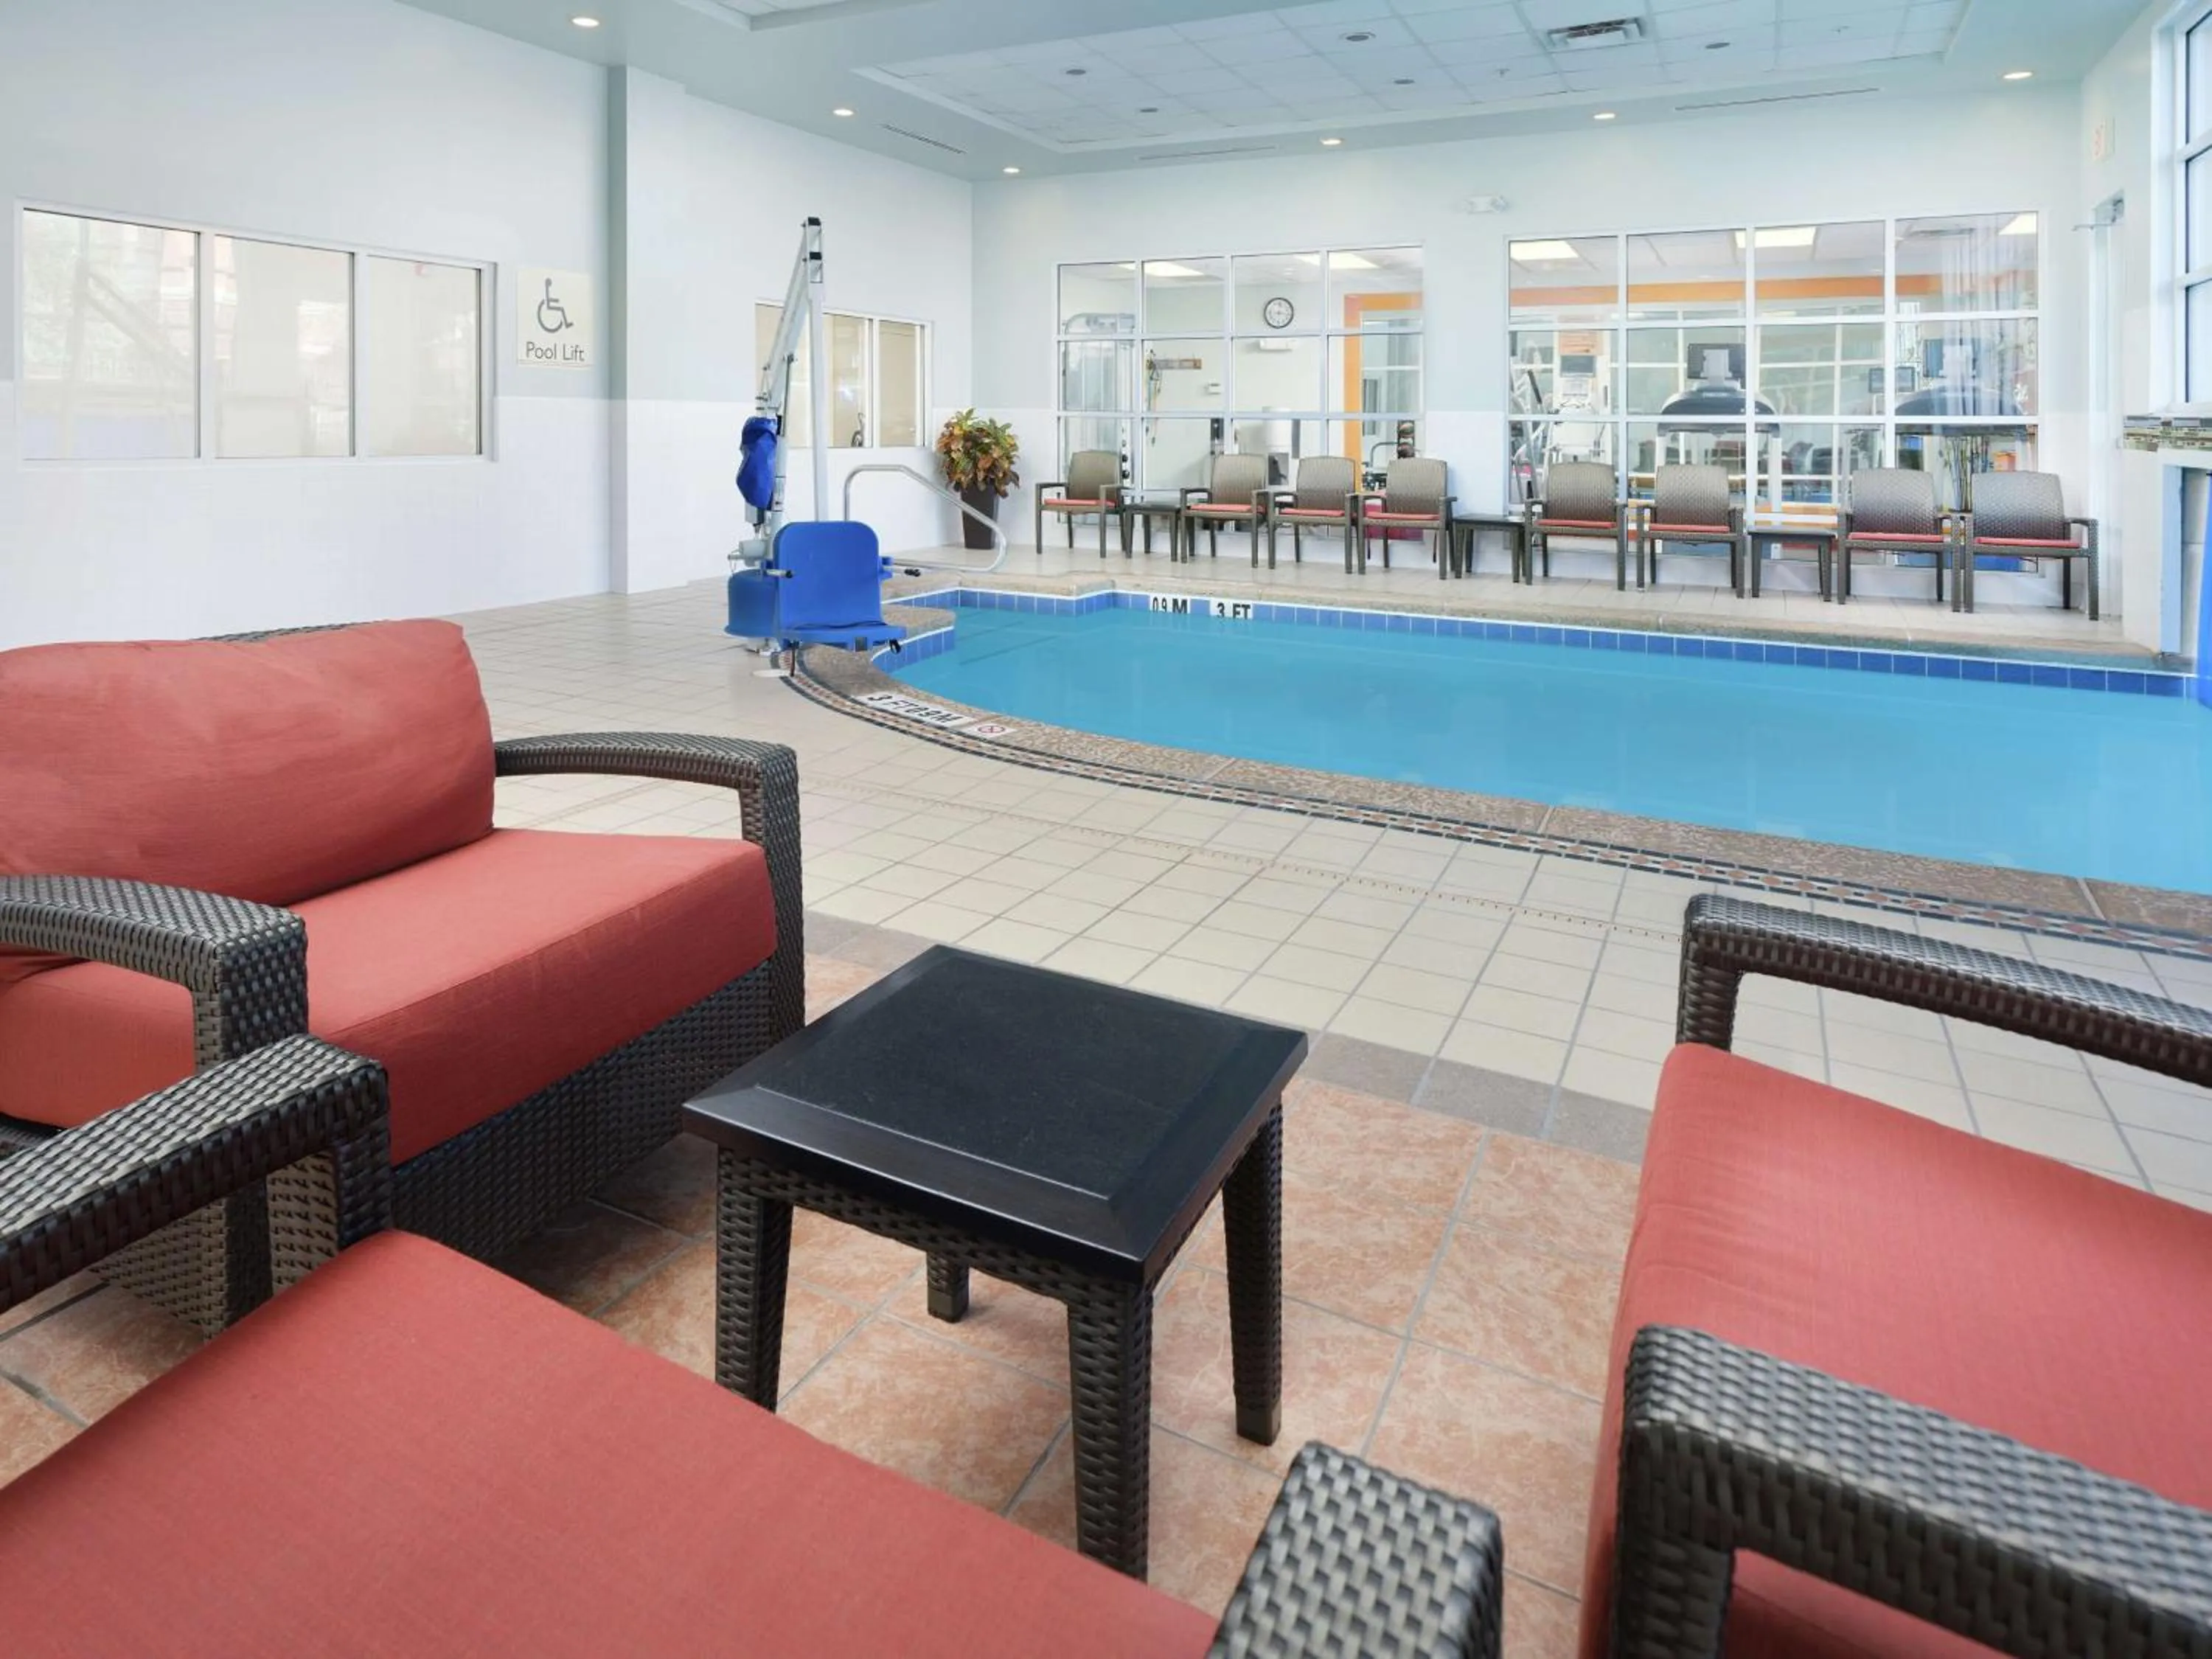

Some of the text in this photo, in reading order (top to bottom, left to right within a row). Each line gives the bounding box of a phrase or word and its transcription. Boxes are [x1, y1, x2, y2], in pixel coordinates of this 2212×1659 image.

[526, 341, 585, 361] Pool Lift
[1217, 602, 1251, 620] 3 FT
